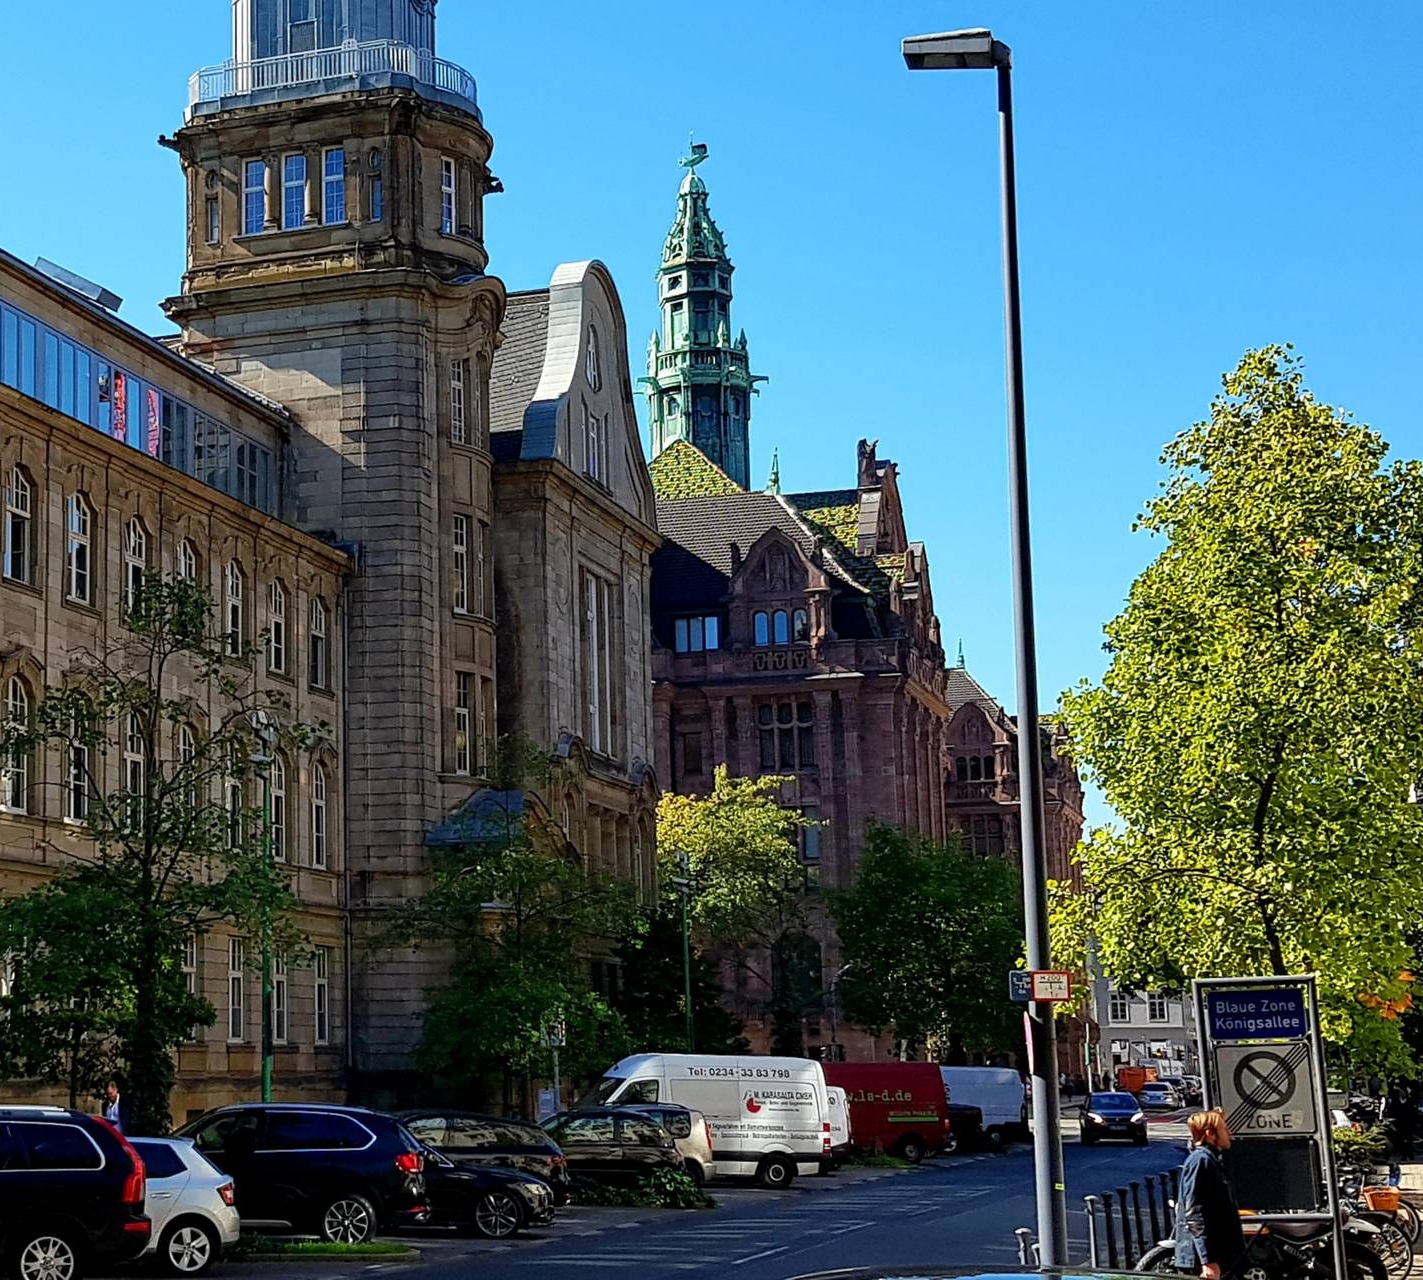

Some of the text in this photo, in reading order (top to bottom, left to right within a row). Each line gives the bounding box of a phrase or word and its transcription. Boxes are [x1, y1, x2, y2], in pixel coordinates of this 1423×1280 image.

[1215, 1000, 1296, 1014] Blaue Zone
[1215, 1015, 1300, 1032] Königsallee
[687, 1067, 707, 1076] Tel:
[756, 1069, 769, 1077] 83
[771, 1069, 790, 1078] 798
[1246, 1114, 1293, 1129] ZONE
